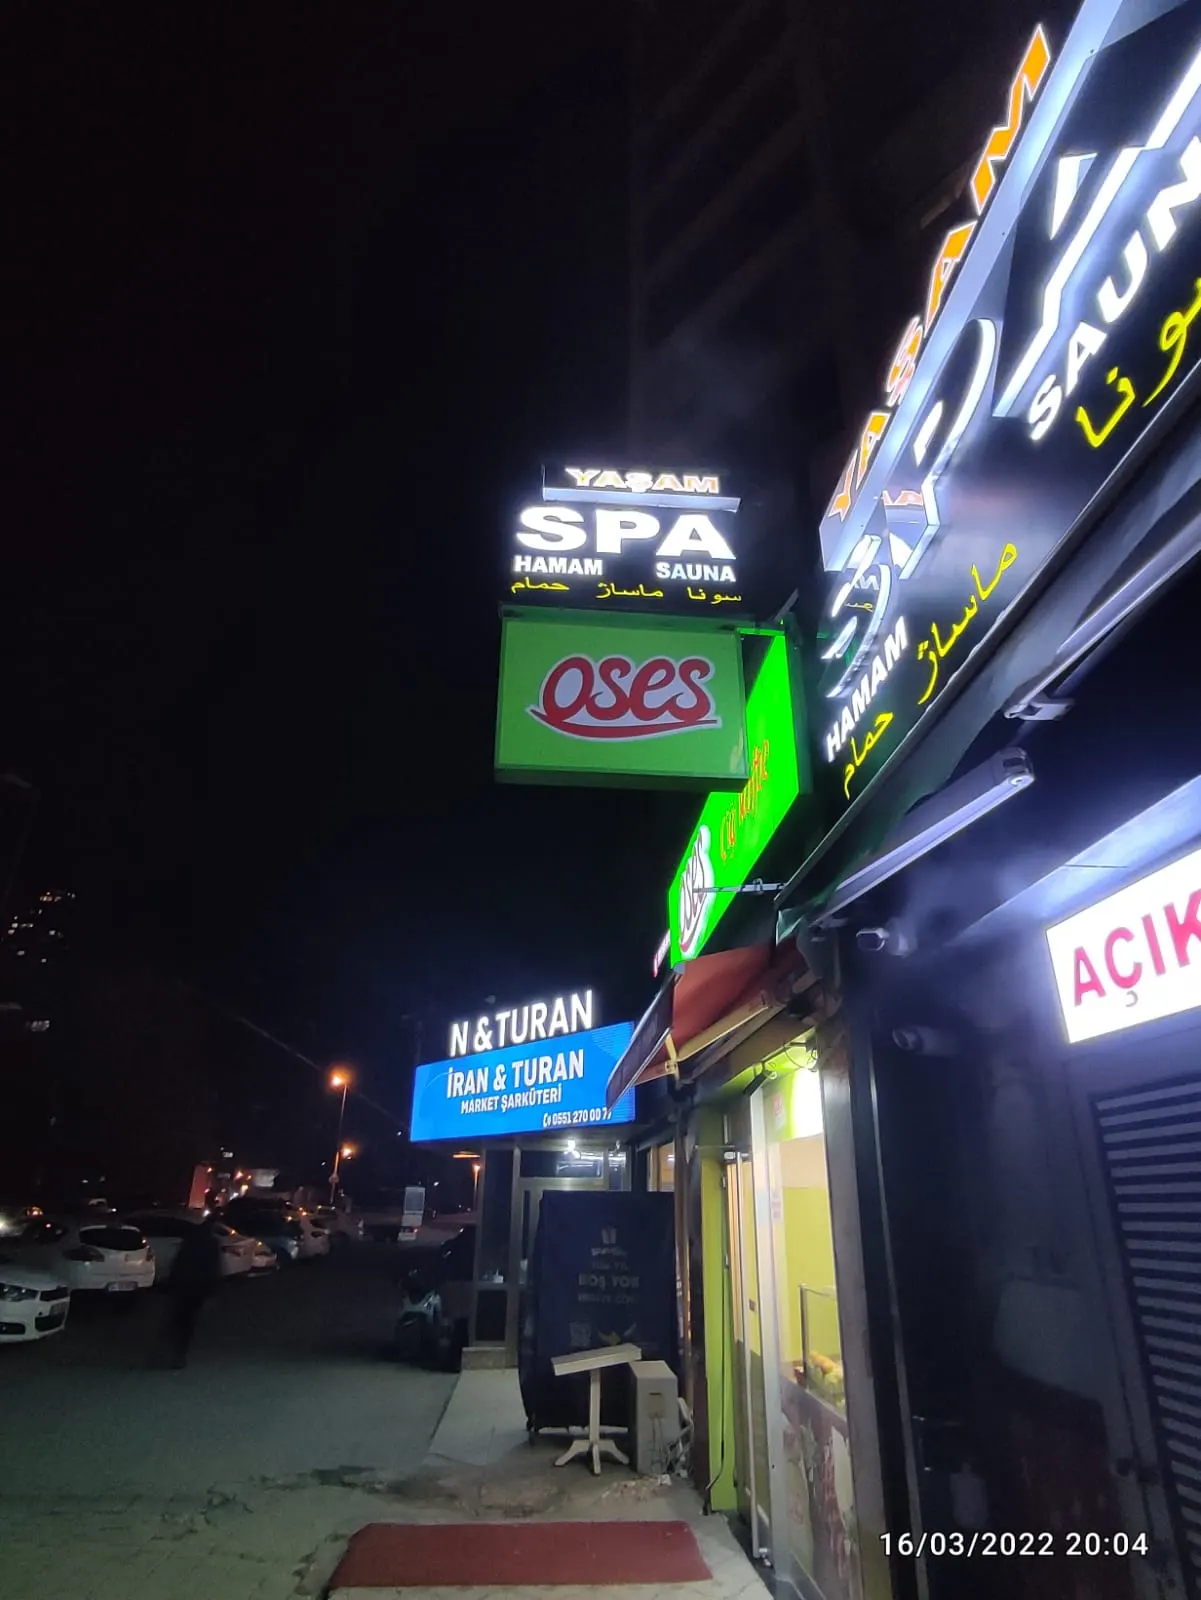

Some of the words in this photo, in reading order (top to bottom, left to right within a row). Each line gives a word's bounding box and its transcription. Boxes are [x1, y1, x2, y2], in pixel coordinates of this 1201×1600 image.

[565, 468, 720, 494] YAŞAM
[516, 506, 737, 560] SPA
[511, 576, 571, 593] حمام
[513, 555, 604, 576] HAMAM
[655, 562, 737, 583] SAUNA
[825, 616, 909, 763] HAMAM
[1074, 889, 1201, 1007] AÇIK
[450, 1020, 469, 1057] N
[473, 1015, 494, 1051] &
[496, 989, 594, 1047] TURAN
[446, 1067, 489, 1098] İRAN
[493, 1064, 507, 1091] &
[512, 1049, 584, 1088] TURAN
[460, 1095, 499, 1114] MARKET
[501, 1083, 562, 1113] ŞARKÜTERİ
[552, 1112, 571, 1127] 0551
[572, 1110, 588, 1124] 270
[589, 1108, 600, 1121] 00
